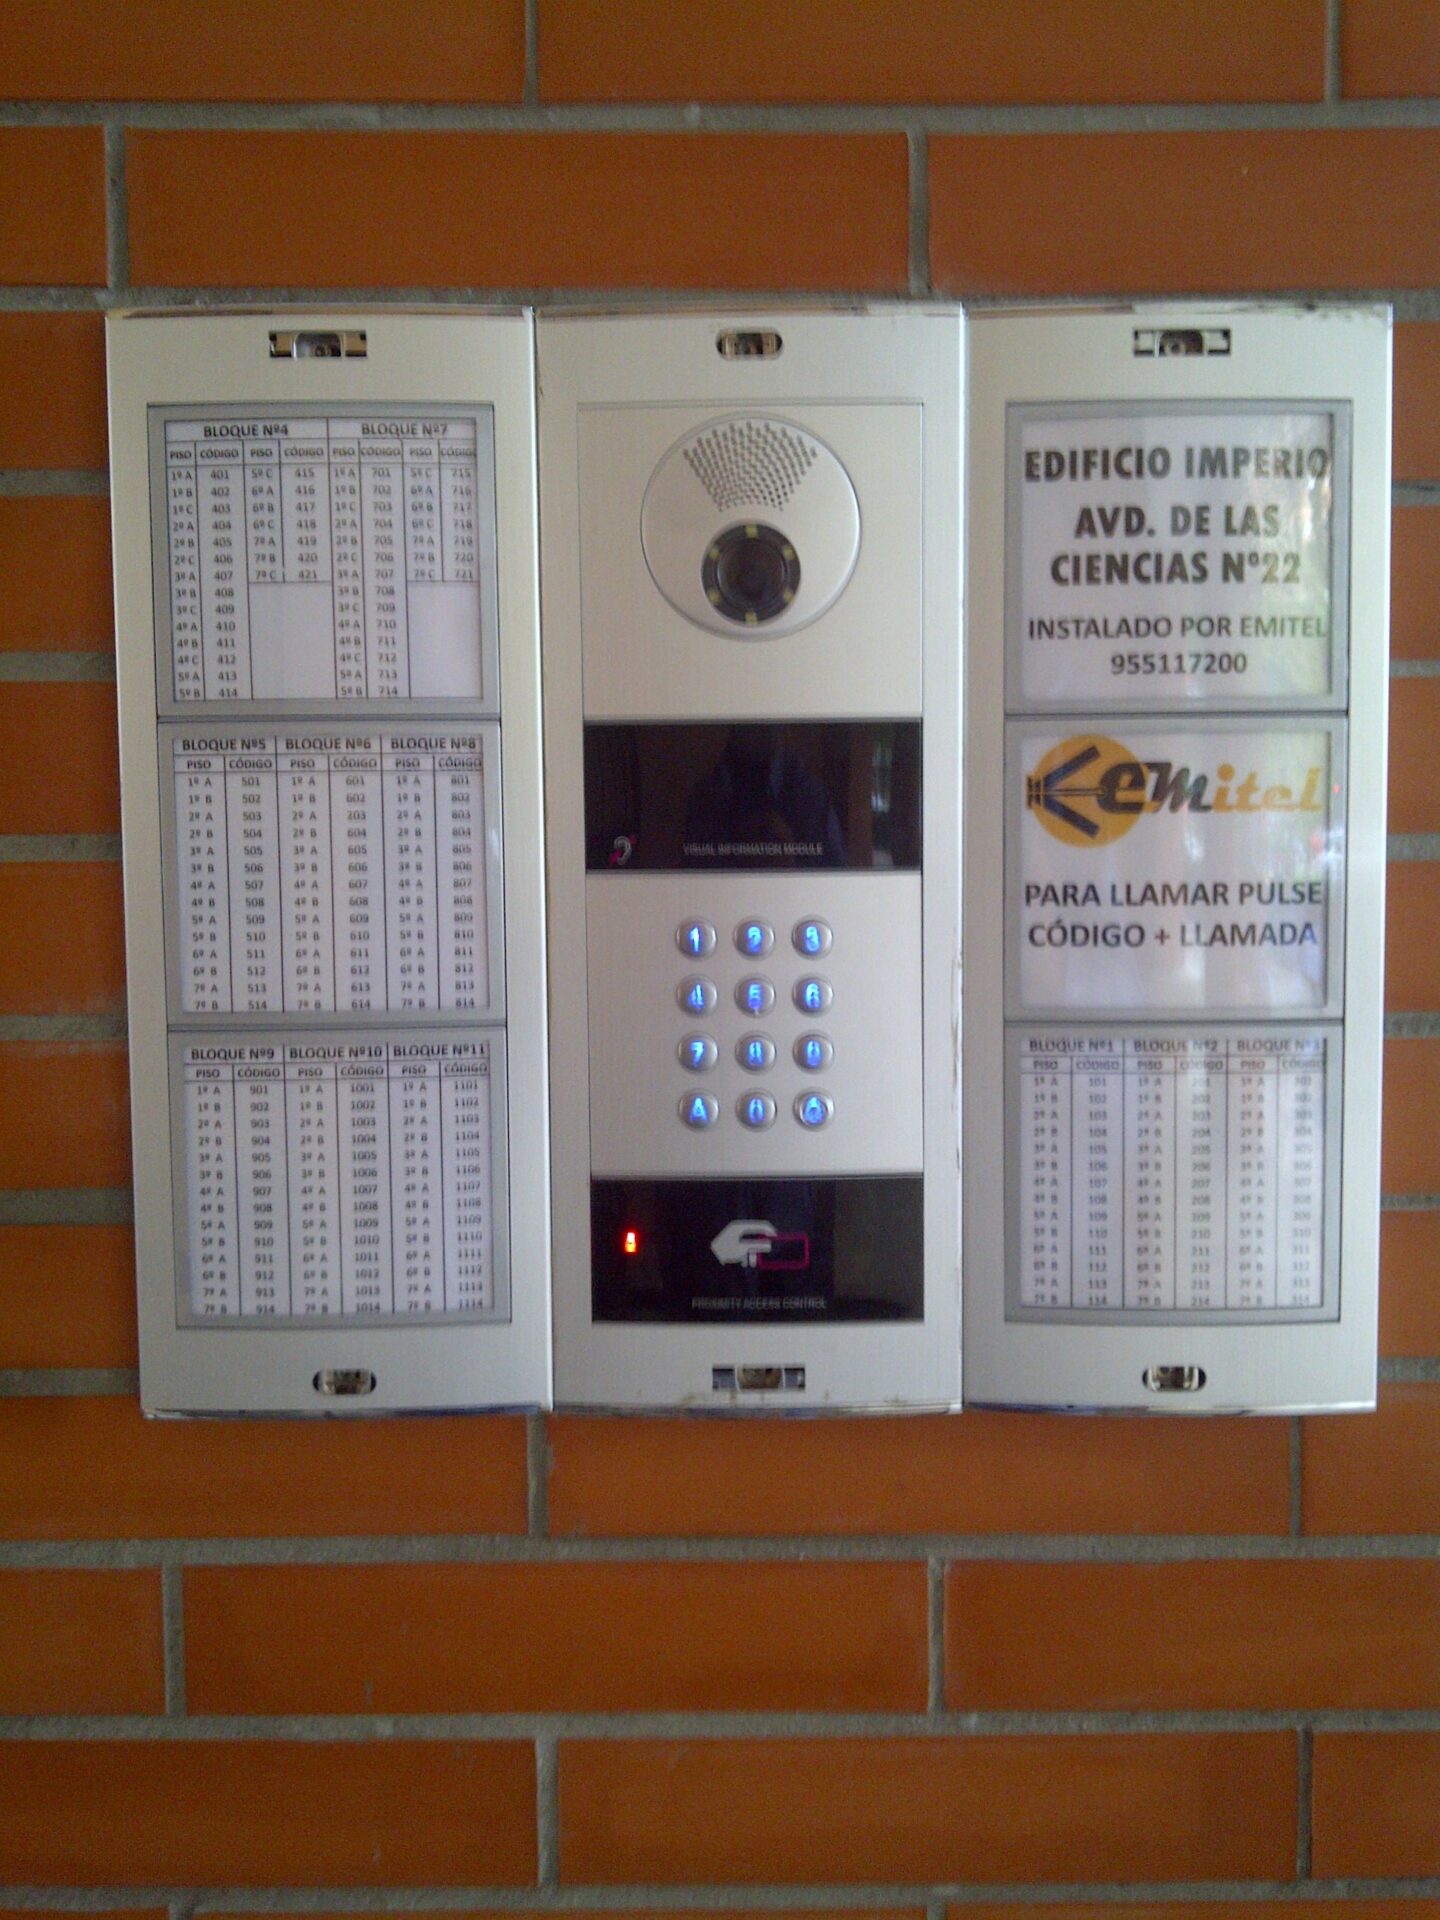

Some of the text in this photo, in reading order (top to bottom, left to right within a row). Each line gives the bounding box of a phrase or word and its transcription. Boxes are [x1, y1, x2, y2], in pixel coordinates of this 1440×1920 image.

[203, 425, 288, 437] BLOQUE Nº4
[362, 424, 448, 435] BLOQUE Nº7
[170, 450, 192, 460] PISO
[200, 447, 238, 458] CÓDIGO
[251, 448, 273, 457] PISO
[284, 446, 324, 457] CÓDIGO
[333, 448, 355, 457] PISO
[360, 447, 401, 457] CÓDIGO
[410, 448, 432, 457] PISO
[1025, 447, 1328, 483] EDIFICIO IMPERIO
[210, 470, 229, 480] 401
[295, 469, 314, 479] 415
[211, 487, 230, 497] 402
[296, 485, 315, 496] 416
[212, 503, 231, 513] 403
[296, 502, 315, 512] 417
[212, 520, 231, 530] 404
[297, 519, 316, 529] 418
[1074, 505, 1280, 539] AVD. DE LAS
[213, 537, 232, 547] 405
[297, 536, 317, 546] 419
[214, 554, 233, 564] 406
[298, 553, 317, 563] 420
[1051, 552, 1208, 586] CIENCIAS
[214, 571, 233, 581] 407
[298, 570, 318, 580] 421
[215, 588, 234, 597] 408
[216, 604, 235, 614] 409
[216, 621, 235, 631] 410
[1029, 616, 1328, 640] INSTALADO POR EMITEL
[217, 638, 236, 648] 411
[217, 655, 237, 665] 412
[1111, 653, 1247, 676] 955117200
[218, 672, 237, 681] 413
[219, 689, 238, 698] 414
[182, 738, 266, 751] BLOQUE Nº5
[286, 738, 371, 750] BLOQUE Nº6
[391, 738, 476, 750] BLOQUE Nº8
[187, 760, 211, 769] PISO
[229, 758, 272, 769] CÓDIGO
[290, 759, 315, 768] PISO
[334, 757, 377, 768] CÓDIGO
[396, 759, 420, 767] PISO
[242, 777, 260, 787] 501
[242, 795, 261, 804] 502
[243, 812, 261, 821] 503
[243, 829, 262, 838] 504
[244, 846, 262, 856] 505
[244, 863, 263, 873] 506
[245, 880, 263, 890] 507
[1025, 882, 1322, 906] PARA LLAMAR PULSE
[245, 897, 264, 907] 508
[245, 915, 264, 924] 509
[246, 932, 265, 941] 510
[1029, 918, 1317, 948] CÓDIGO + LLAMADA
[246, 949, 265, 958] 511
[247, 966, 265, 976] 512
[247, 983, 266, 993] 513
[248, 1000, 266, 1010] 514
[393, 1045, 485, 1058] BLOQUE Nº11
[1029, 1041, 1114, 1053] BLOQUE Nº1
[1134, 1041, 1187, 1053] BLOQUE
[1237, 1041, 1291, 1052] BLOQUE
[191, 1048, 275, 1061] BLOQUE Nº9
[290, 1047, 382, 1060] BLOQUE Nº10
[445, 1063, 488, 1074] CÓDIGO
[1033, 1060, 1058, 1070] PISO
[1076, 1059, 1119, 1070] CÓDIGO
[1137, 1060, 1162, 1069] PISO
[1241, 1060, 1265, 1069] PISO
[196, 1069, 220, 1078] PISO
[238, 1066, 280, 1077] CÓDIGO
[298, 1068, 322, 1076] PISO
[341, 1065, 384, 1076] CÓDIGO
[402, 1066, 426, 1075] PISO
[250, 1086, 268, 1095] 901
[250, 1103, 268, 1112] 902
[251, 1120, 269, 1129] 903
[251, 1137, 270, 1146] 904
[252, 1153, 270, 1163] 905
[252, 1170, 271, 1180] 906
[253, 1187, 271, 1196] 907
[253, 1204, 272, 1213] 908
[254, 1220, 272, 1230] 909
[254, 1237, 273, 1247] 910
[254, 1254, 273, 1264] 911
[255, 1271, 274, 1281] 912
[255, 1288, 274, 1297] 913
[256, 1304, 275, 1314] 914
